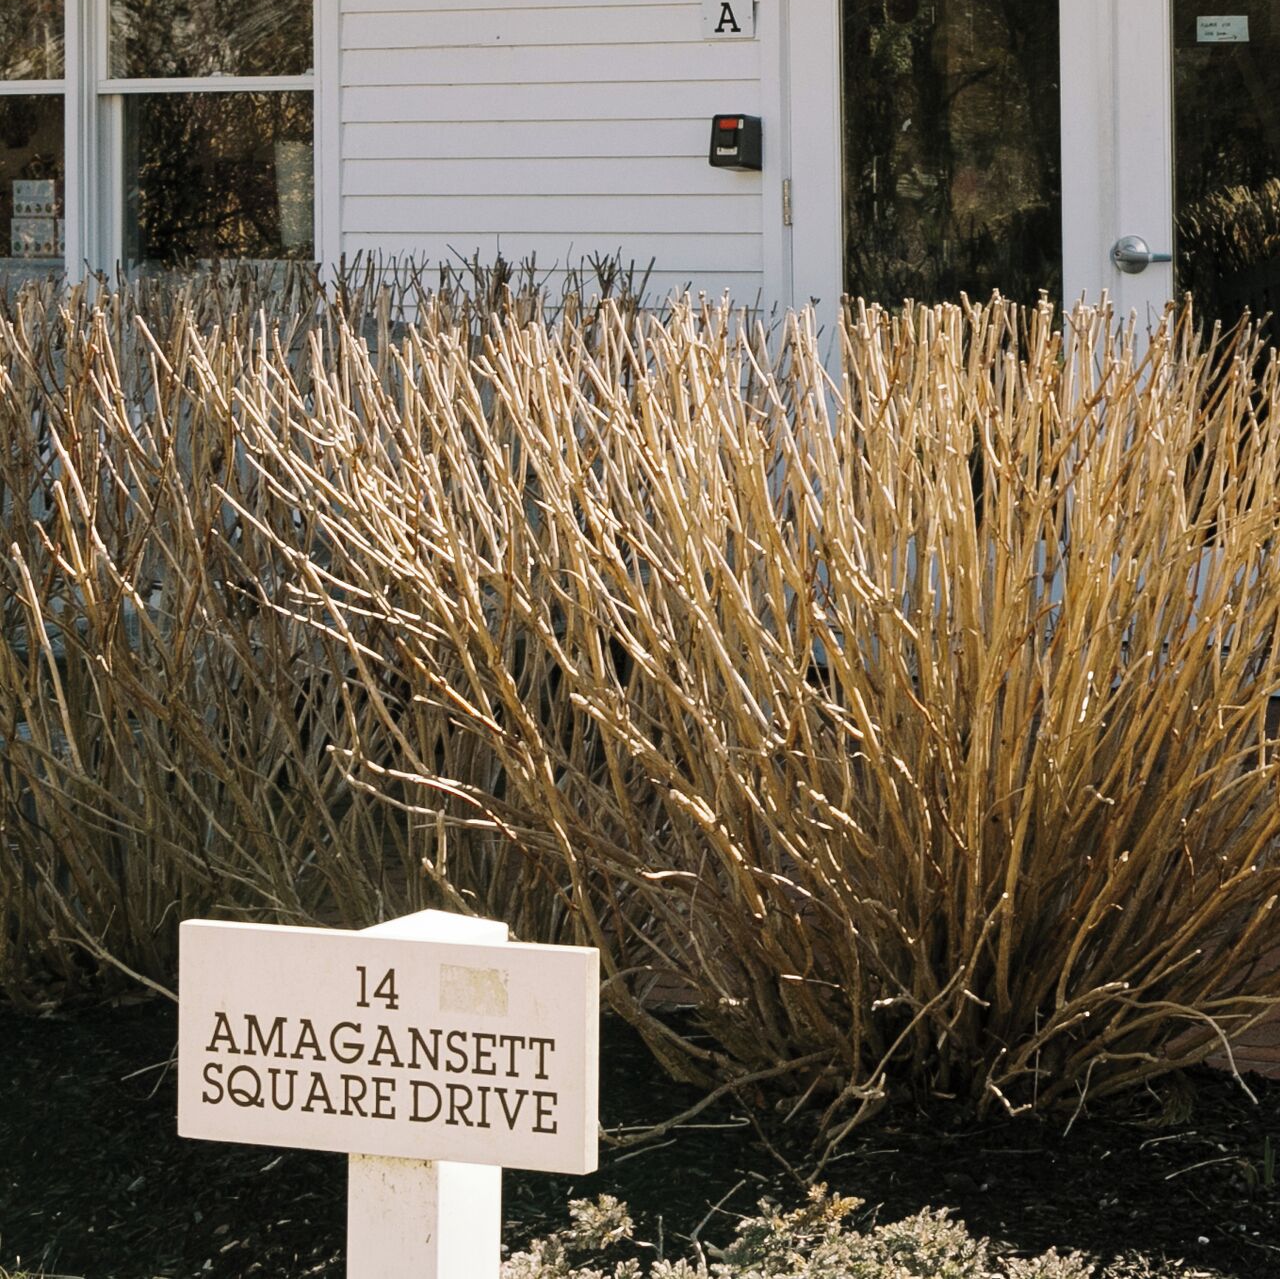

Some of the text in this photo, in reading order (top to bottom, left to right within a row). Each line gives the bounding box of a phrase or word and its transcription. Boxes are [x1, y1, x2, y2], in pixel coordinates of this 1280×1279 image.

[714, 2, 741, 33] A
[356, 965, 399, 1010] 14
[205, 1011, 555, 1080] AMAGANSETT
[202, 1062, 558, 1135] SQUARE DRIVE
